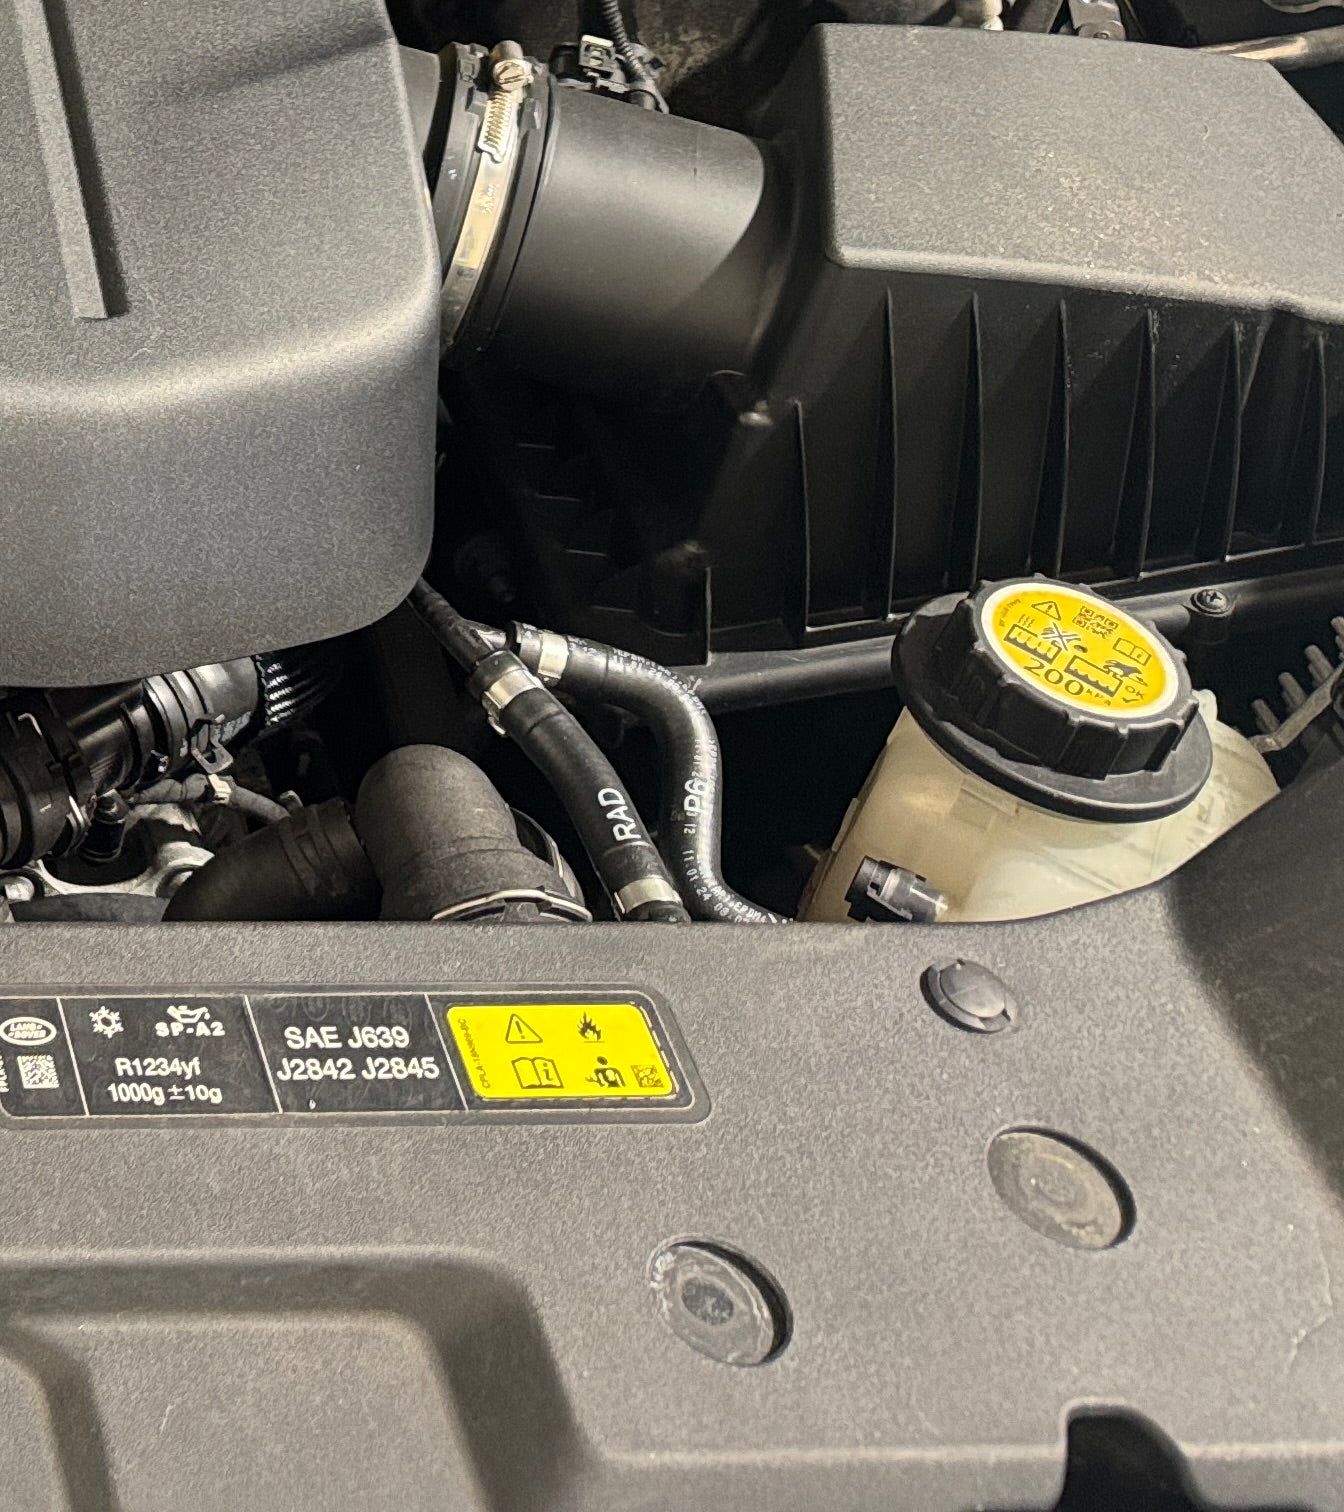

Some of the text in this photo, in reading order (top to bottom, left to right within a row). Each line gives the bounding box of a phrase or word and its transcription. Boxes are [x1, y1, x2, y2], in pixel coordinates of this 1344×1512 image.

[1023, 657, 1085, 696] 200
[1124, 685, 1146, 700] OK
[683, 777, 709, 816] P6
[597, 787, 642, 842] RAD
[154, 1021, 226, 1037] SP-A2
[283, 1025, 410, 1050] SAE J639
[114, 1056, 201, 1080] R1234yf
[276, 1056, 440, 1081] J2842 J2845
[107, 1082, 223, 1106] 1000g ±10g
